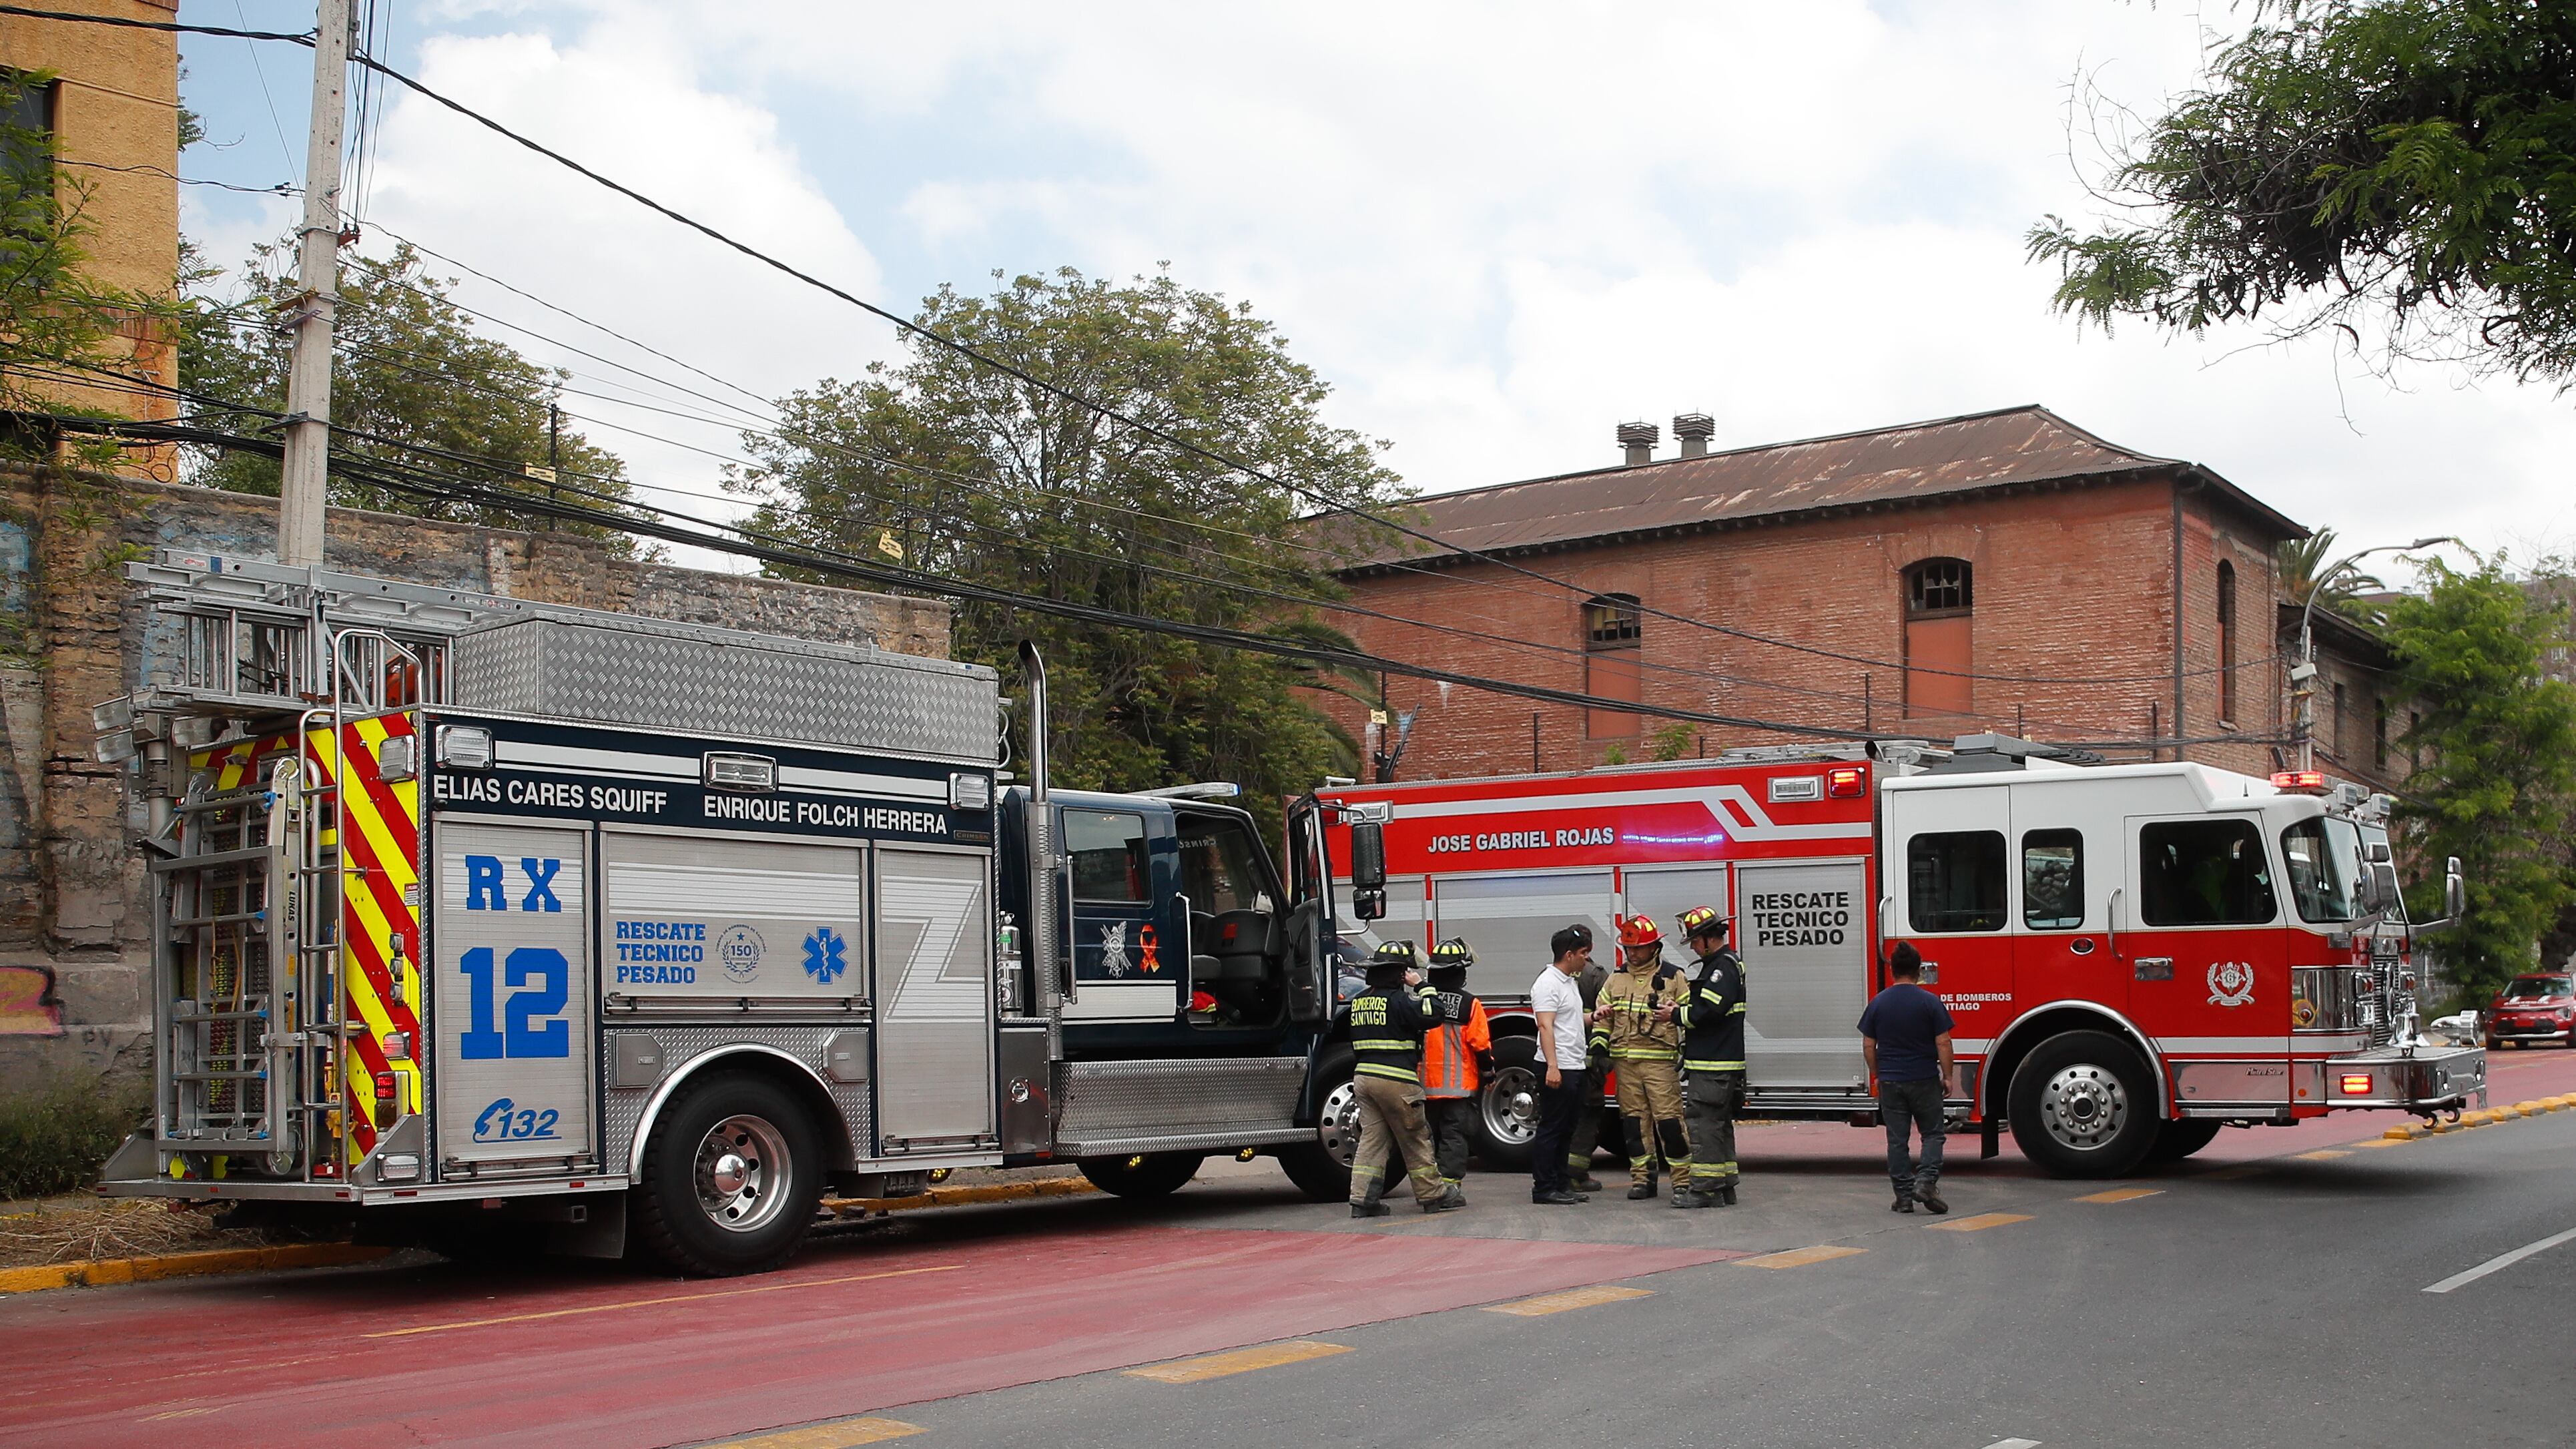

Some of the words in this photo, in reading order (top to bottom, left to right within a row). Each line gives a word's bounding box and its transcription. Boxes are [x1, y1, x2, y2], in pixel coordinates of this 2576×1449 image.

[433, 774, 501, 803] ELIAS
[507, 780, 584, 808] CARES
[590, 786, 667, 814] SQUIFF
[703, 795, 790, 822] ENRIQUE
[797, 802, 858, 827] FOLCH
[864, 807, 948, 834] HERRERA
[1427, 834, 1471, 853] JOSE
[1475, 830, 1551, 850] GABRIEL
[1555, 826, 1614, 847] ROJAS
[288, 891, 296, 922] LUKAS
[1752, 891, 1849, 910] RESCATE
[1752, 910, 1849, 928] TECNICO
[616, 921, 706, 941] RESCATE
[1758, 928, 1844, 946] PESADO
[616, 943, 703, 962] TECNICO
[730, 944, 752, 956] 150
[617, 965, 696, 984] PESADO
[460, 947, 569, 1060] 12
[1351, 996, 1388, 1012] BOMBEROS
[1437, 992, 1462, 1004] CATE
[1940, 994, 1953, 1002] DE
[1956, 992, 2012, 1002] BOMBEROS
[1943, 1002, 1980, 1011] NTIAGO
[1350, 1011, 1387, 1027] SANTIAGO
[497, 1109, 560, 1138] 132
